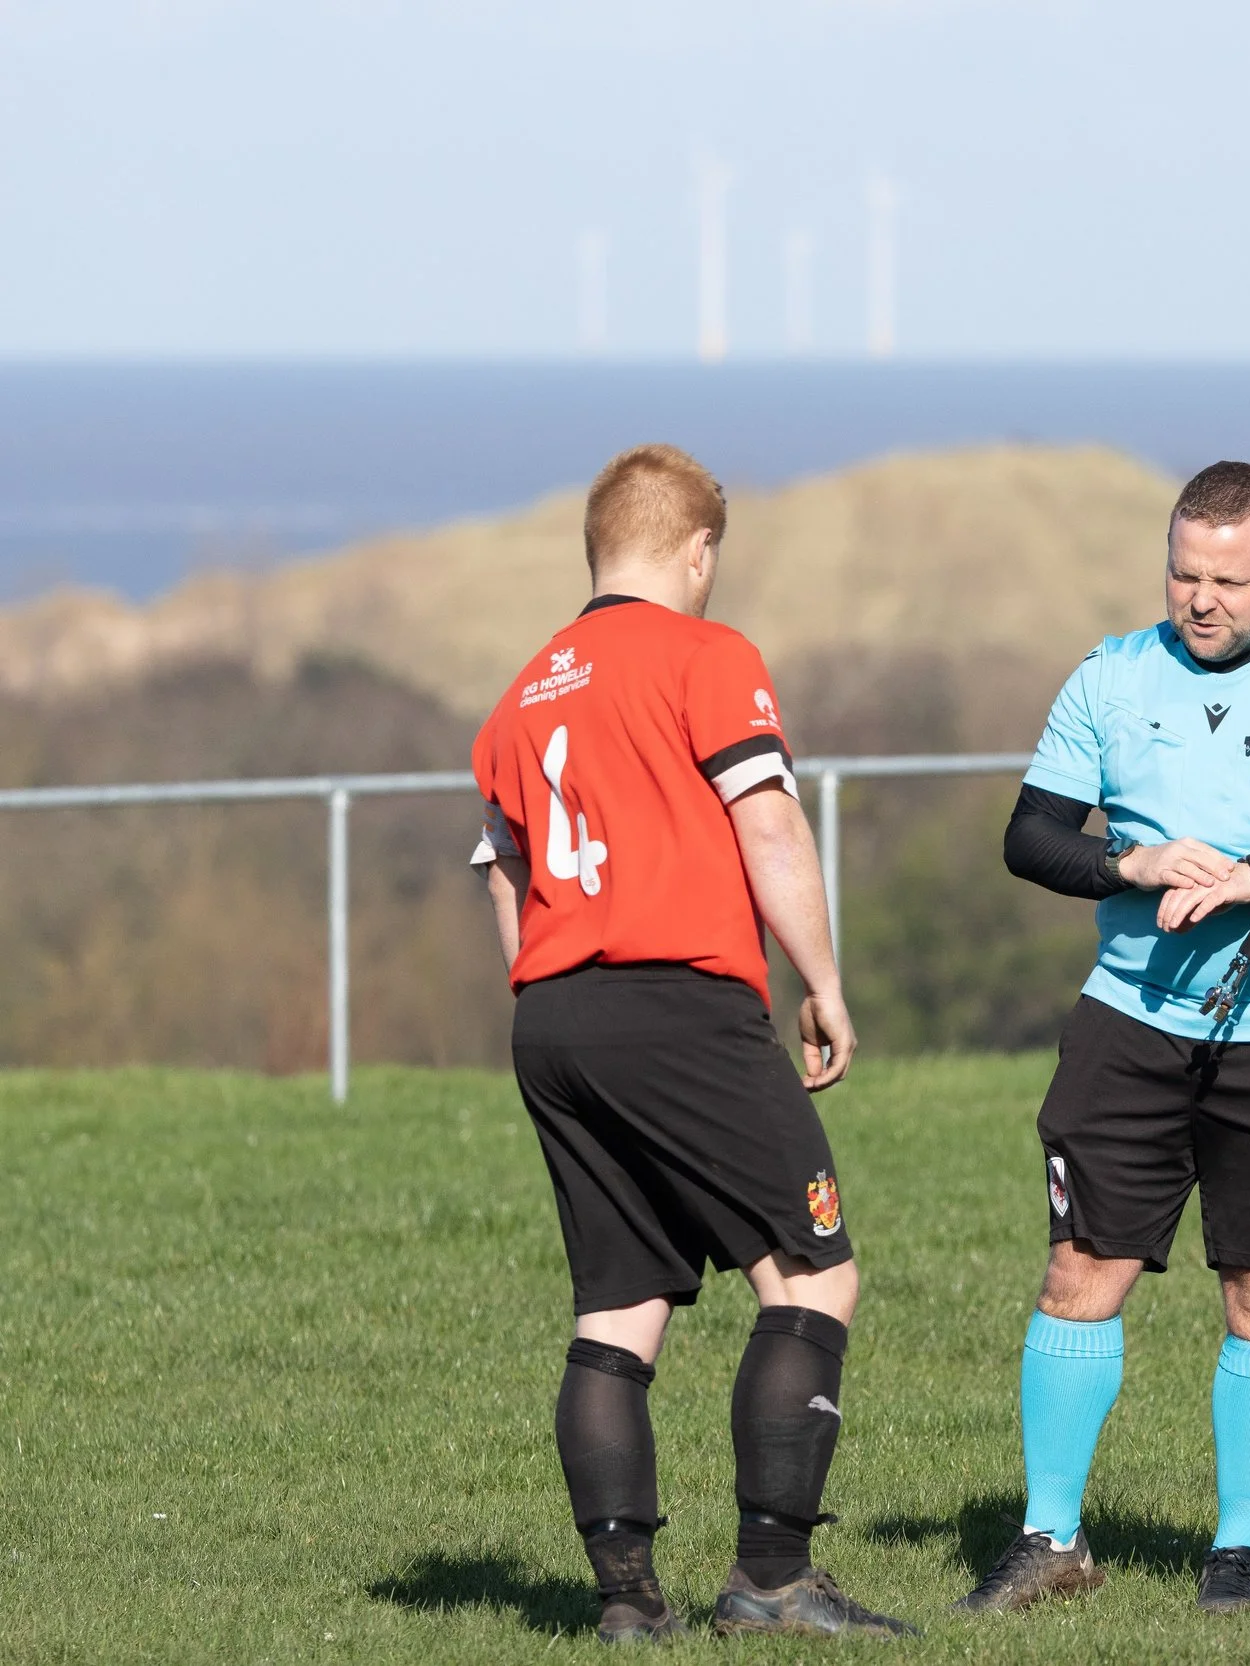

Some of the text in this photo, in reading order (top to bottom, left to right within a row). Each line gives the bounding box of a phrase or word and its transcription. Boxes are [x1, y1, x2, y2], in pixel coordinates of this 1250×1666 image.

[520, 676, 590, 708] cleaning services
[540, 662, 593, 691] HOWELLS
[543, 724, 608, 896] 4
